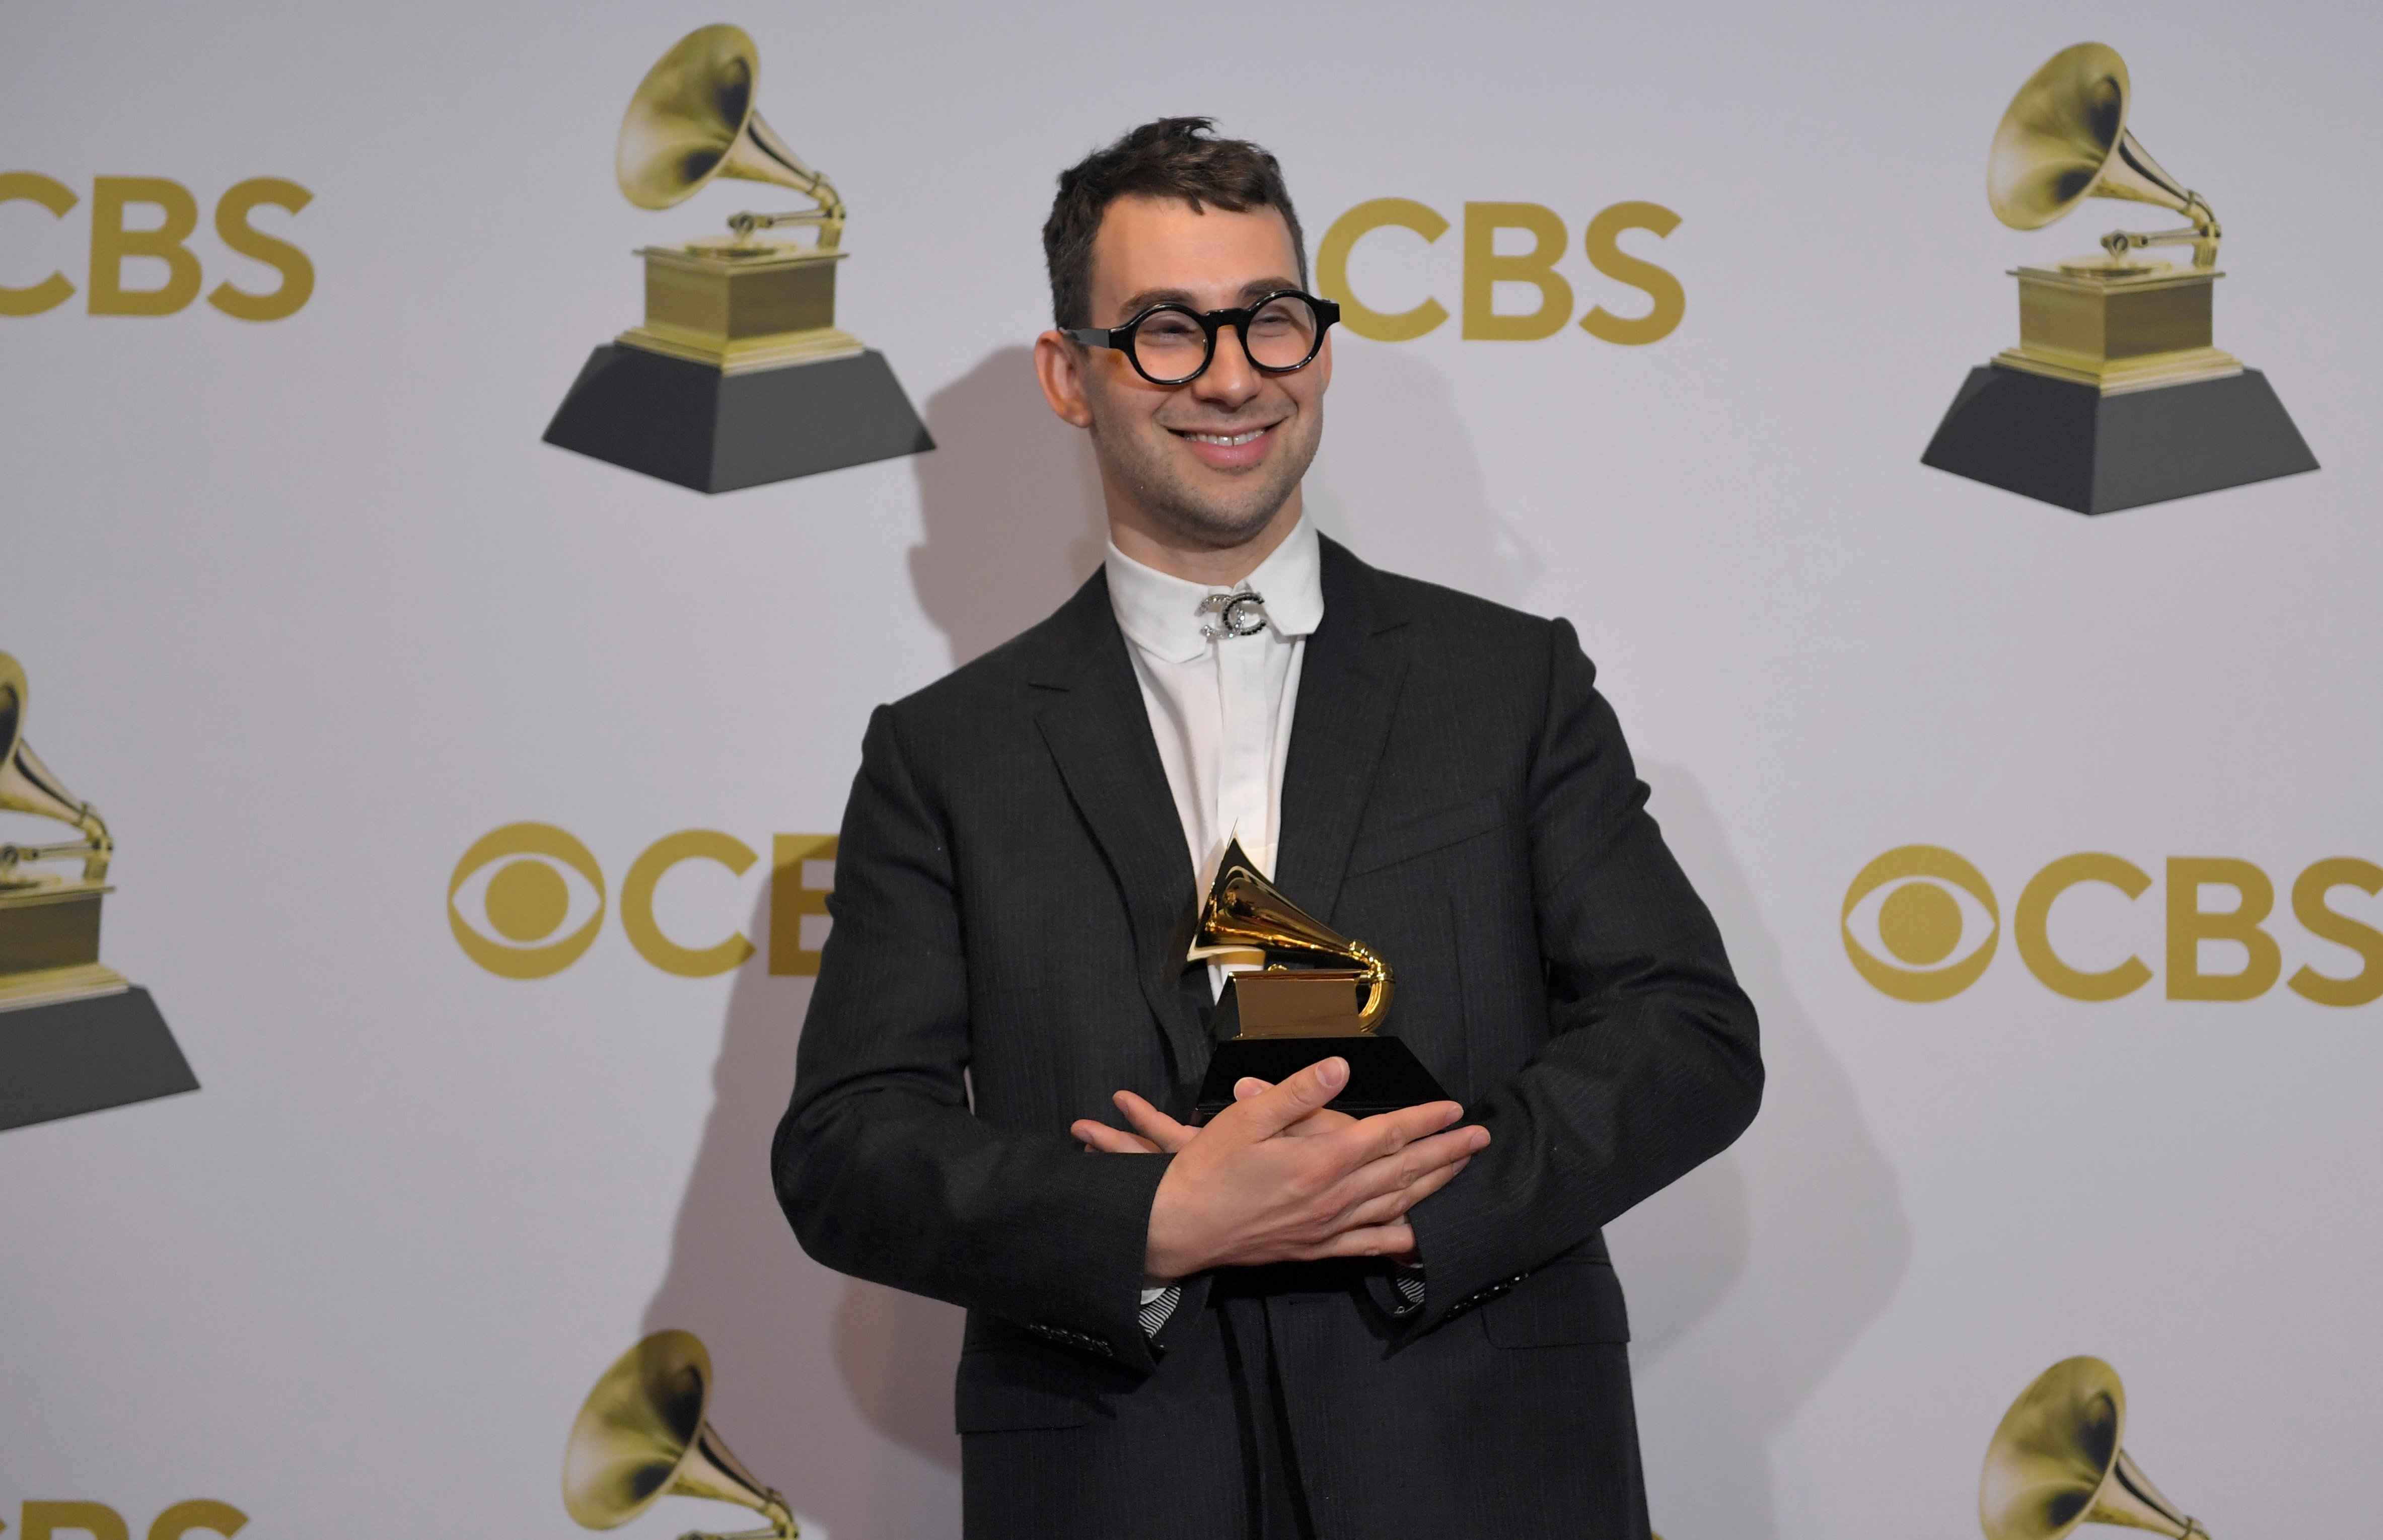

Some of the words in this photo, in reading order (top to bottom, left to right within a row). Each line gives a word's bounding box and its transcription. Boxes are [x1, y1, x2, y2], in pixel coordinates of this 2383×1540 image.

[0, 171, 316, 323] CBS
[1316, 197, 1686, 346] CBS
[620, 829, 840, 978] CB
[2014, 852, 2383, 1007] CBS
